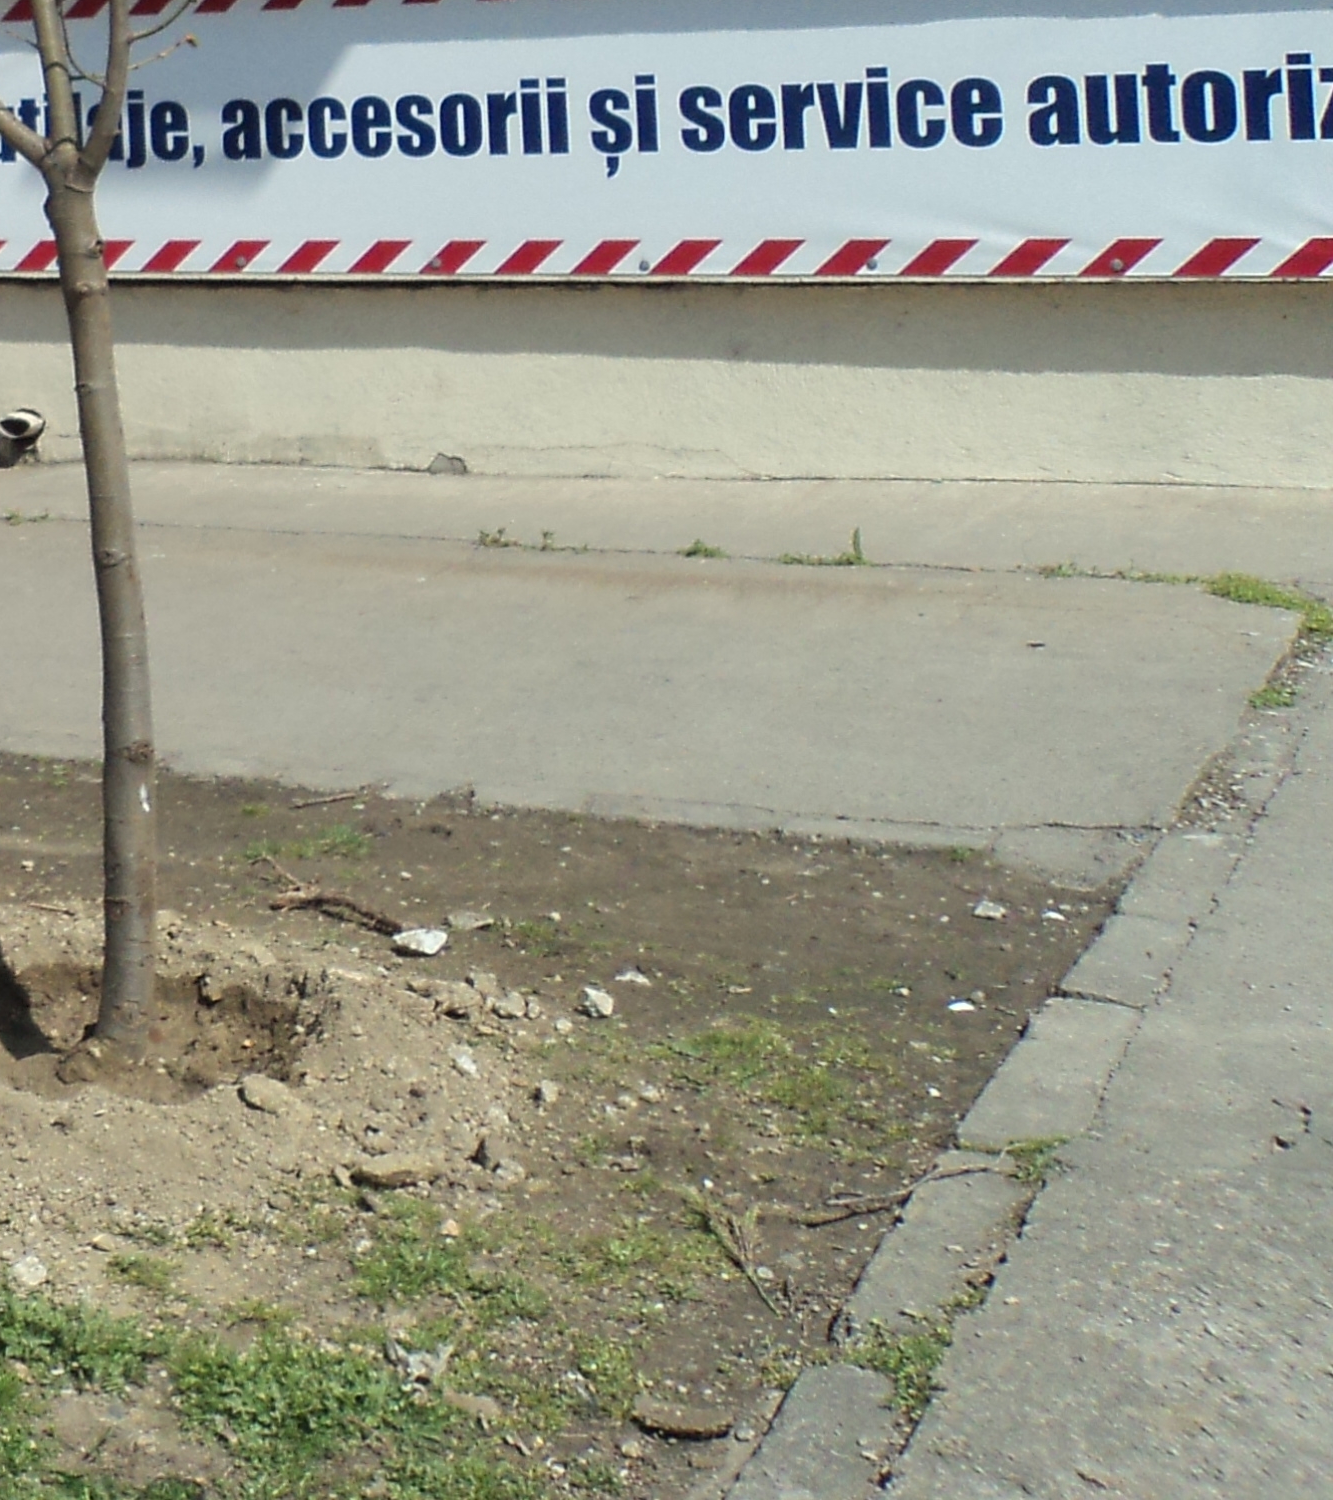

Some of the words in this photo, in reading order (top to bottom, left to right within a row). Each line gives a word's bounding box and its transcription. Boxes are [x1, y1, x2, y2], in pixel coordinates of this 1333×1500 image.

[222, 77, 569, 160] accesorii
[588, 74, 659, 178] și
[679, 66, 1003, 152] service
